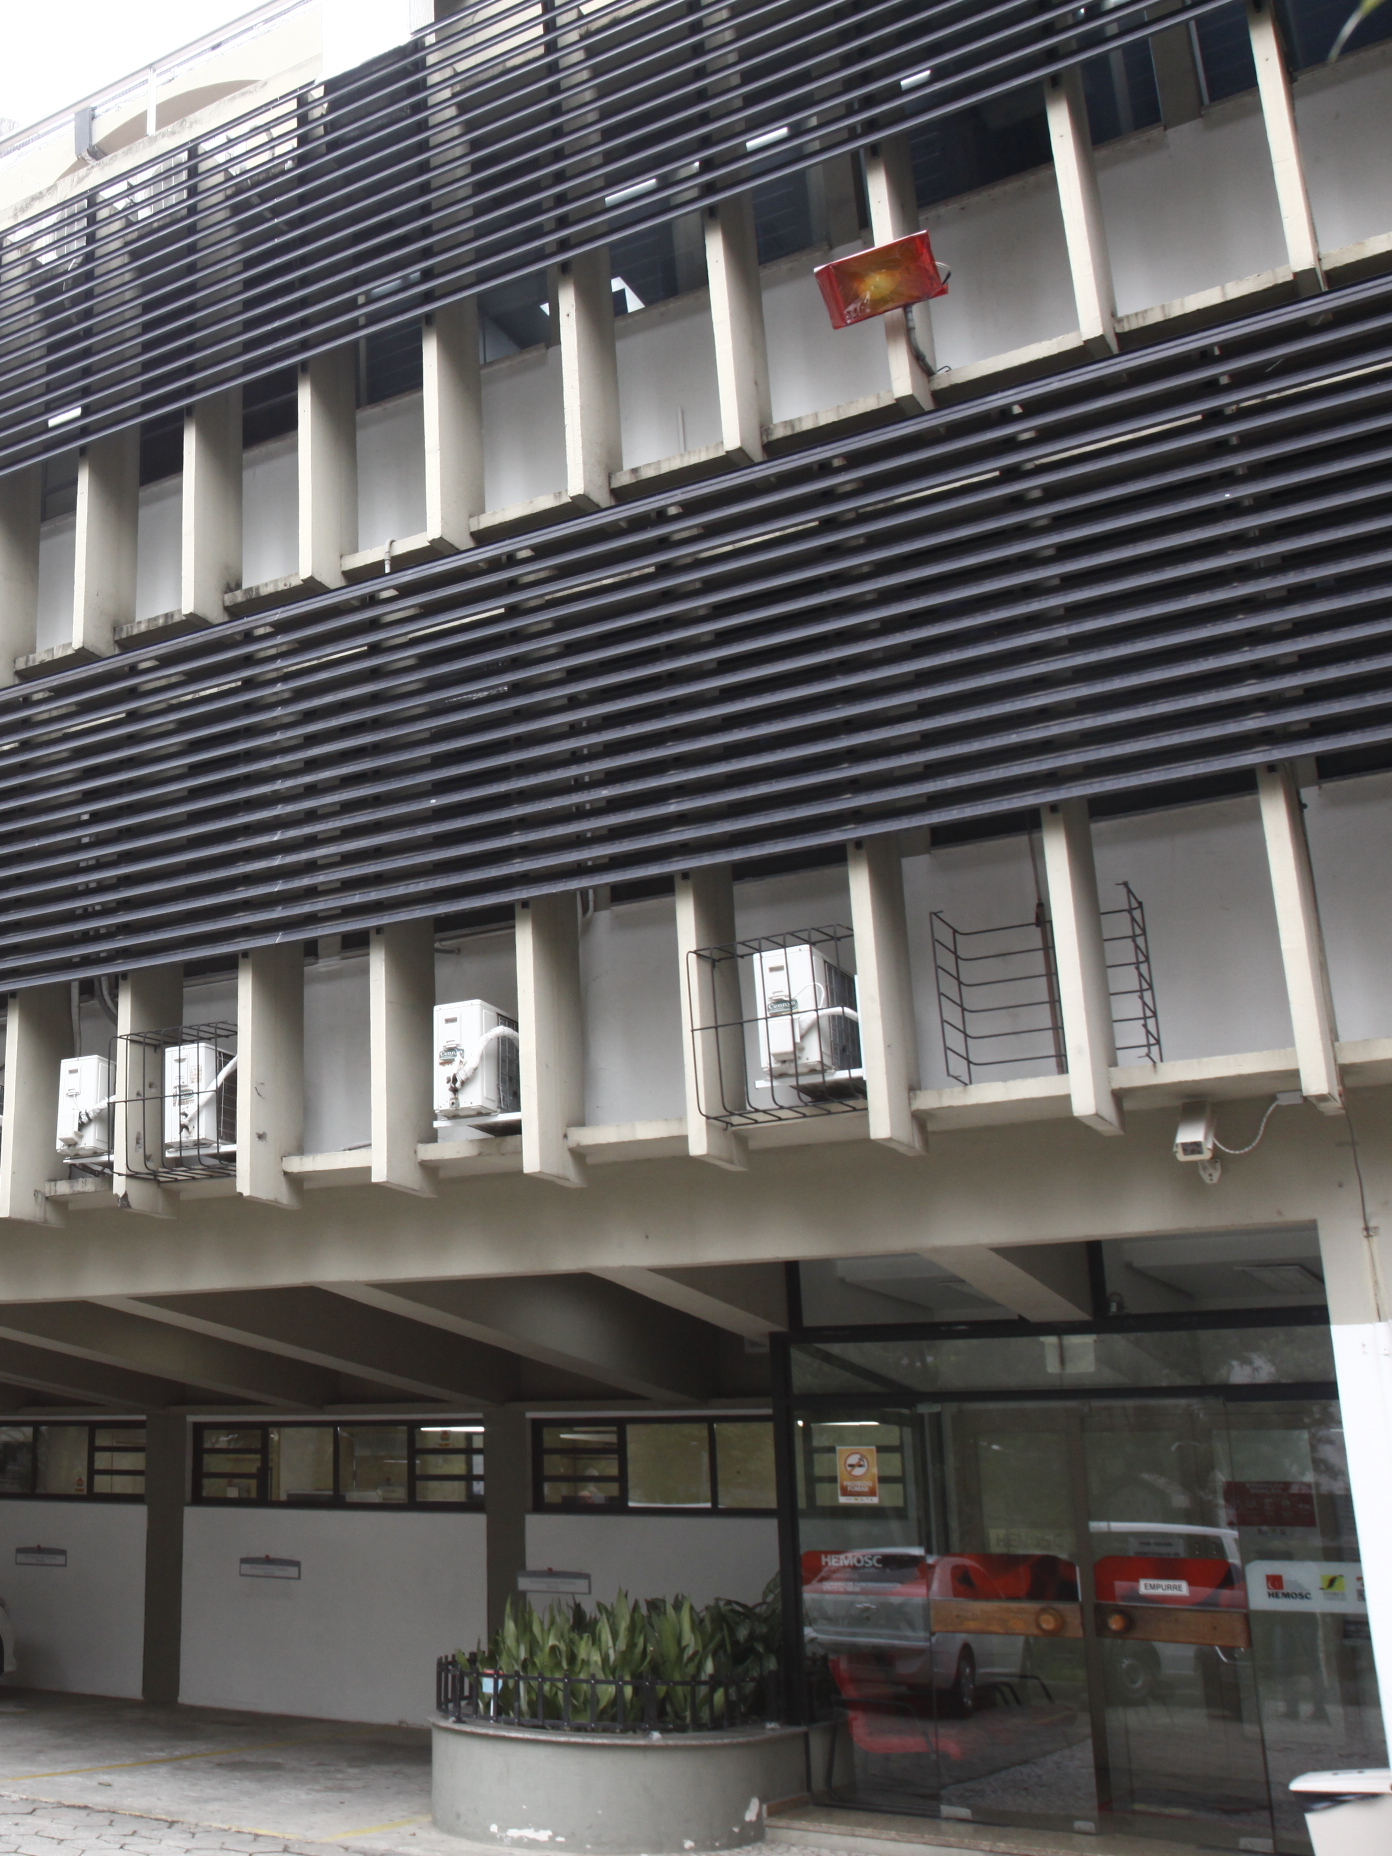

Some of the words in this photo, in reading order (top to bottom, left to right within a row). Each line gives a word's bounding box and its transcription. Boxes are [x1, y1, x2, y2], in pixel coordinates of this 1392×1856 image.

[821, 1554, 883, 1567] HEMOSC
[1143, 1582, 1184, 1592] EMPURRE
[1267, 1591, 1312, 1600] HEMOSC
